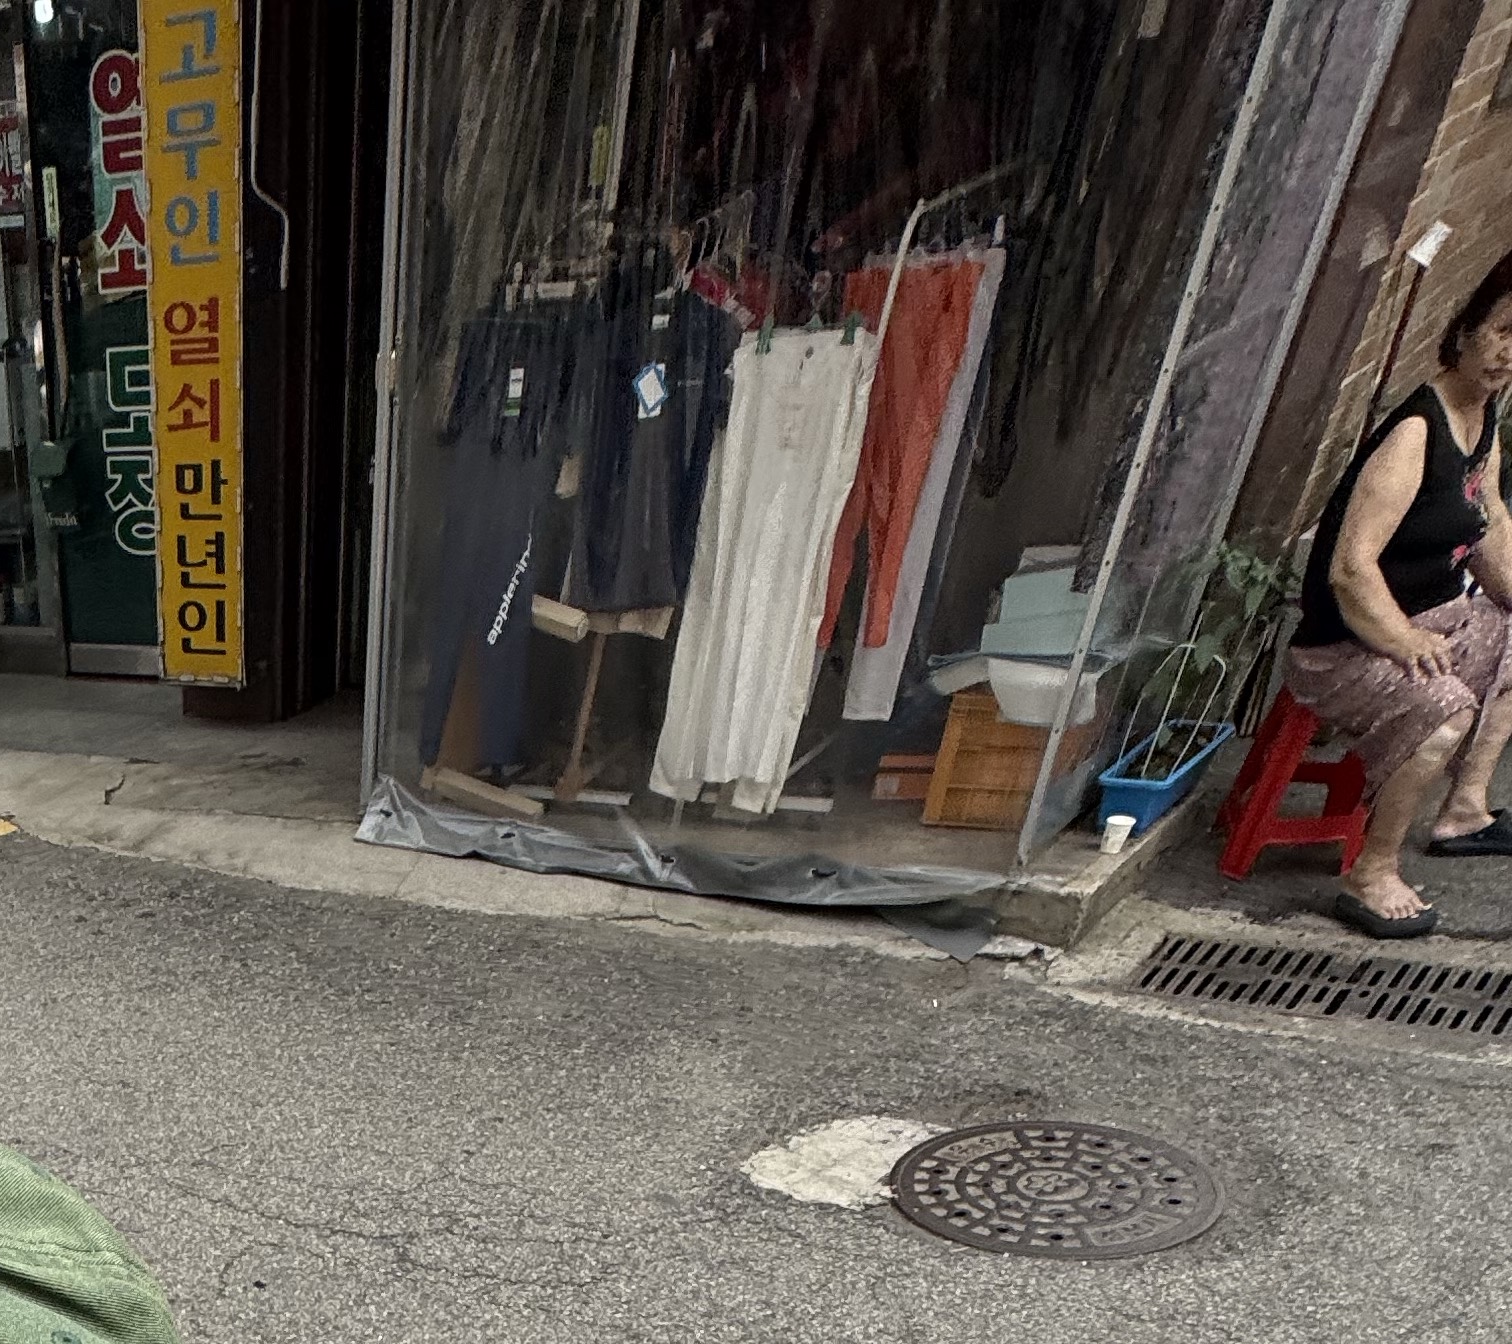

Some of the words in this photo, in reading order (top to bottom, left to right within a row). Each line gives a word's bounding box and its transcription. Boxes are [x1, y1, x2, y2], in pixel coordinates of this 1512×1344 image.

[159, 7, 221, 267] 고무인
[163, 297, 221, 443] 열쇠
[174, 459, 228, 655] 만년인
